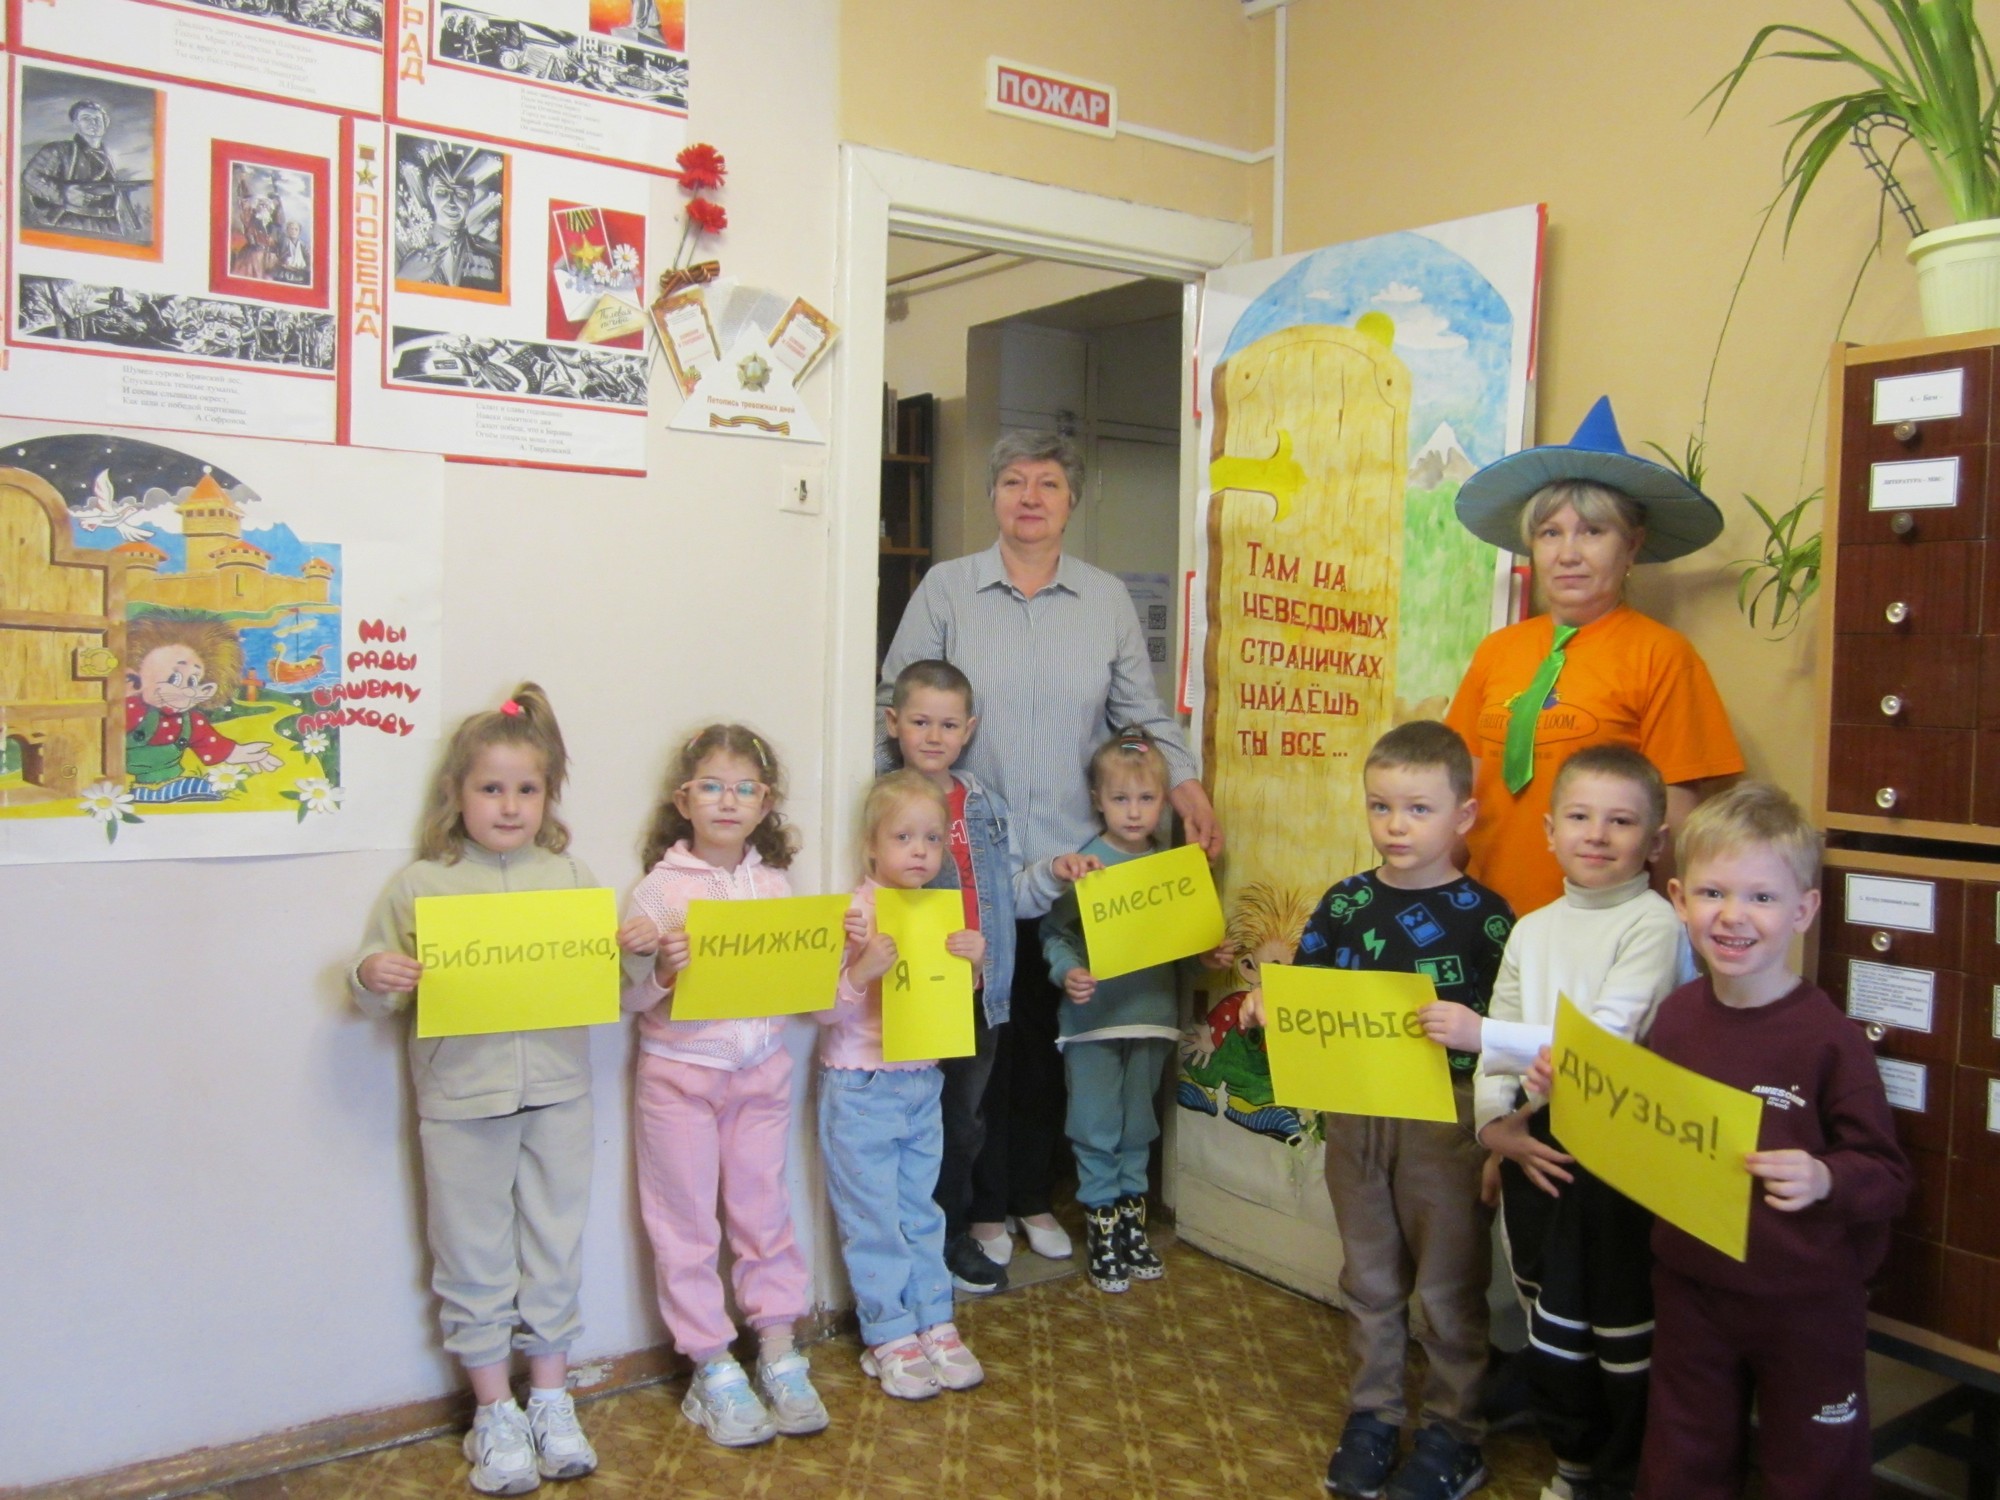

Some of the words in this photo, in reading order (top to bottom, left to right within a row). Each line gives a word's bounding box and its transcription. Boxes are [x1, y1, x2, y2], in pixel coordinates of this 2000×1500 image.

[1000, 72, 1106, 121] ПОЖАР
[355, 192, 380, 339] ПОБЕДА
[707, 395, 739, 407] Летопись
[742, 401, 778, 411] тревожных
[779, 405, 795, 413] дней
[1247, 541, 1300, 583] ТАМ
[358, 618, 407, 644] Мы
[1243, 591, 1389, 640] НЕВЕДОМЫХ
[1240, 638, 1383, 680] СТРАНИЧКАХ
[1240, 681, 1359, 717] НАЙДЁШЬ
[296, 707, 415, 737] ПРИХОДУ
[1544, 713, 1577, 730] LOOM
[1237, 730, 1268, 756] ТЫ
[1092, 876, 1196, 923] вместе
[421, 937, 616, 970] Библиотека,
[698, 926, 837, 958] книжка,
[1277, 1006, 1427, 1048] верные
[1558, 1047, 1719, 1160] друзья!
